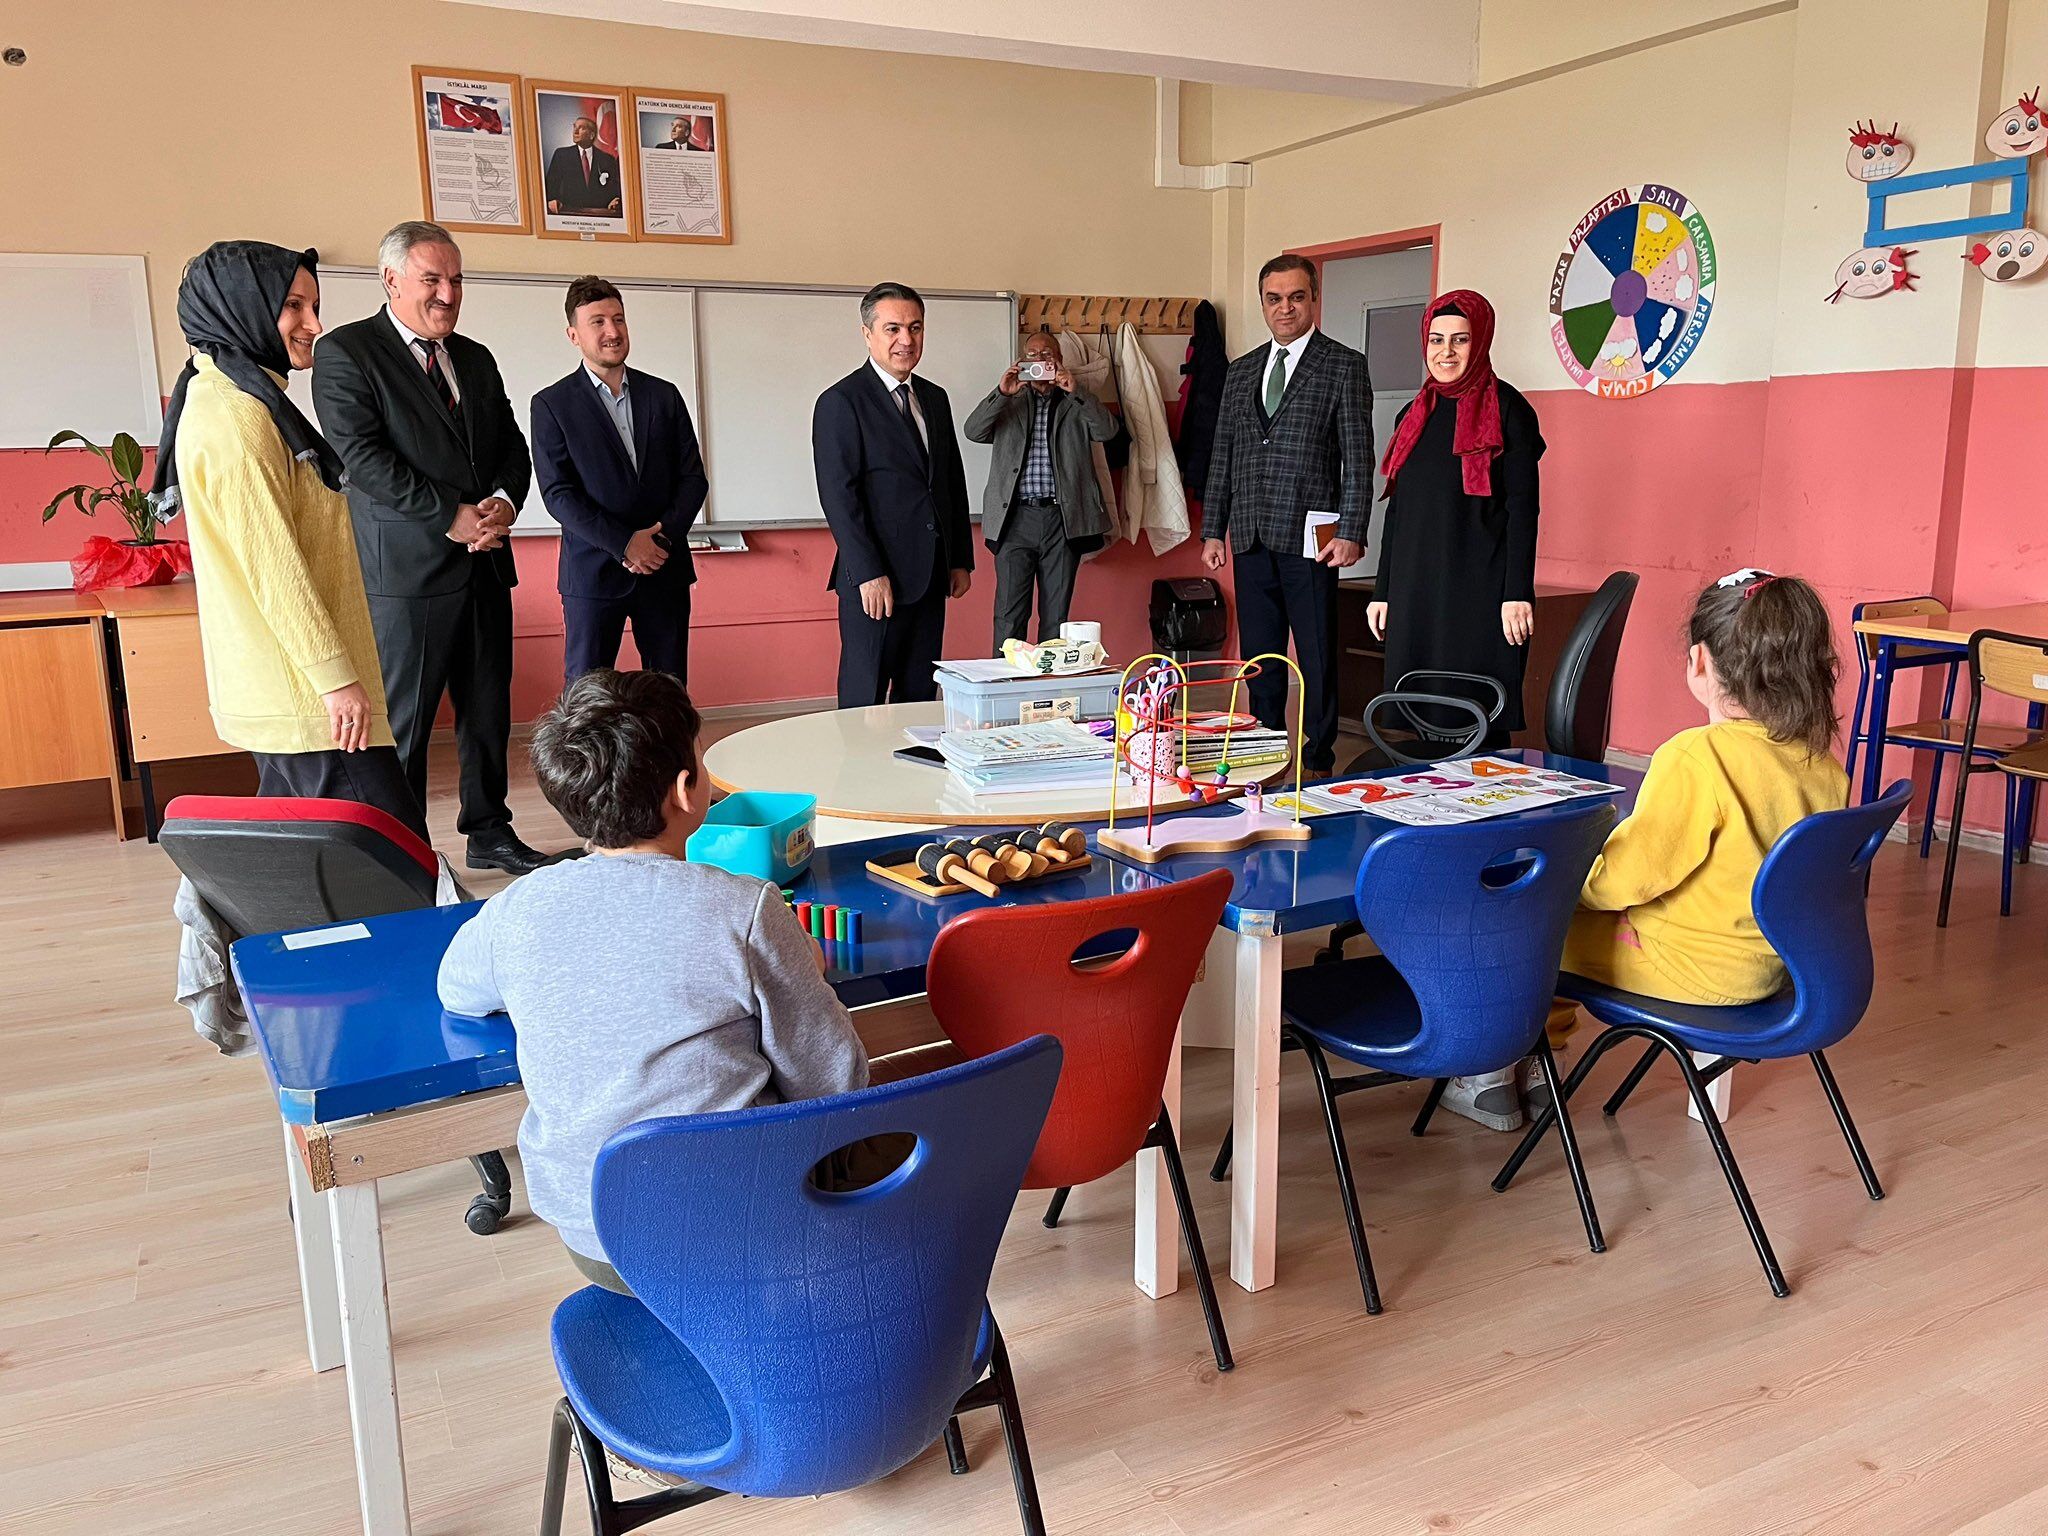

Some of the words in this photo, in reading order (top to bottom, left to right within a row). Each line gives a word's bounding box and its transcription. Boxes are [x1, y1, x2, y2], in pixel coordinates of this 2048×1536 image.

[1600, 378, 1648, 397] CUMA
[1471, 759, 1532, 778] 4
[1400, 775, 1475, 790] 3
[1328, 783, 1419, 804] 2
[1270, 797, 1329, 815] 1
